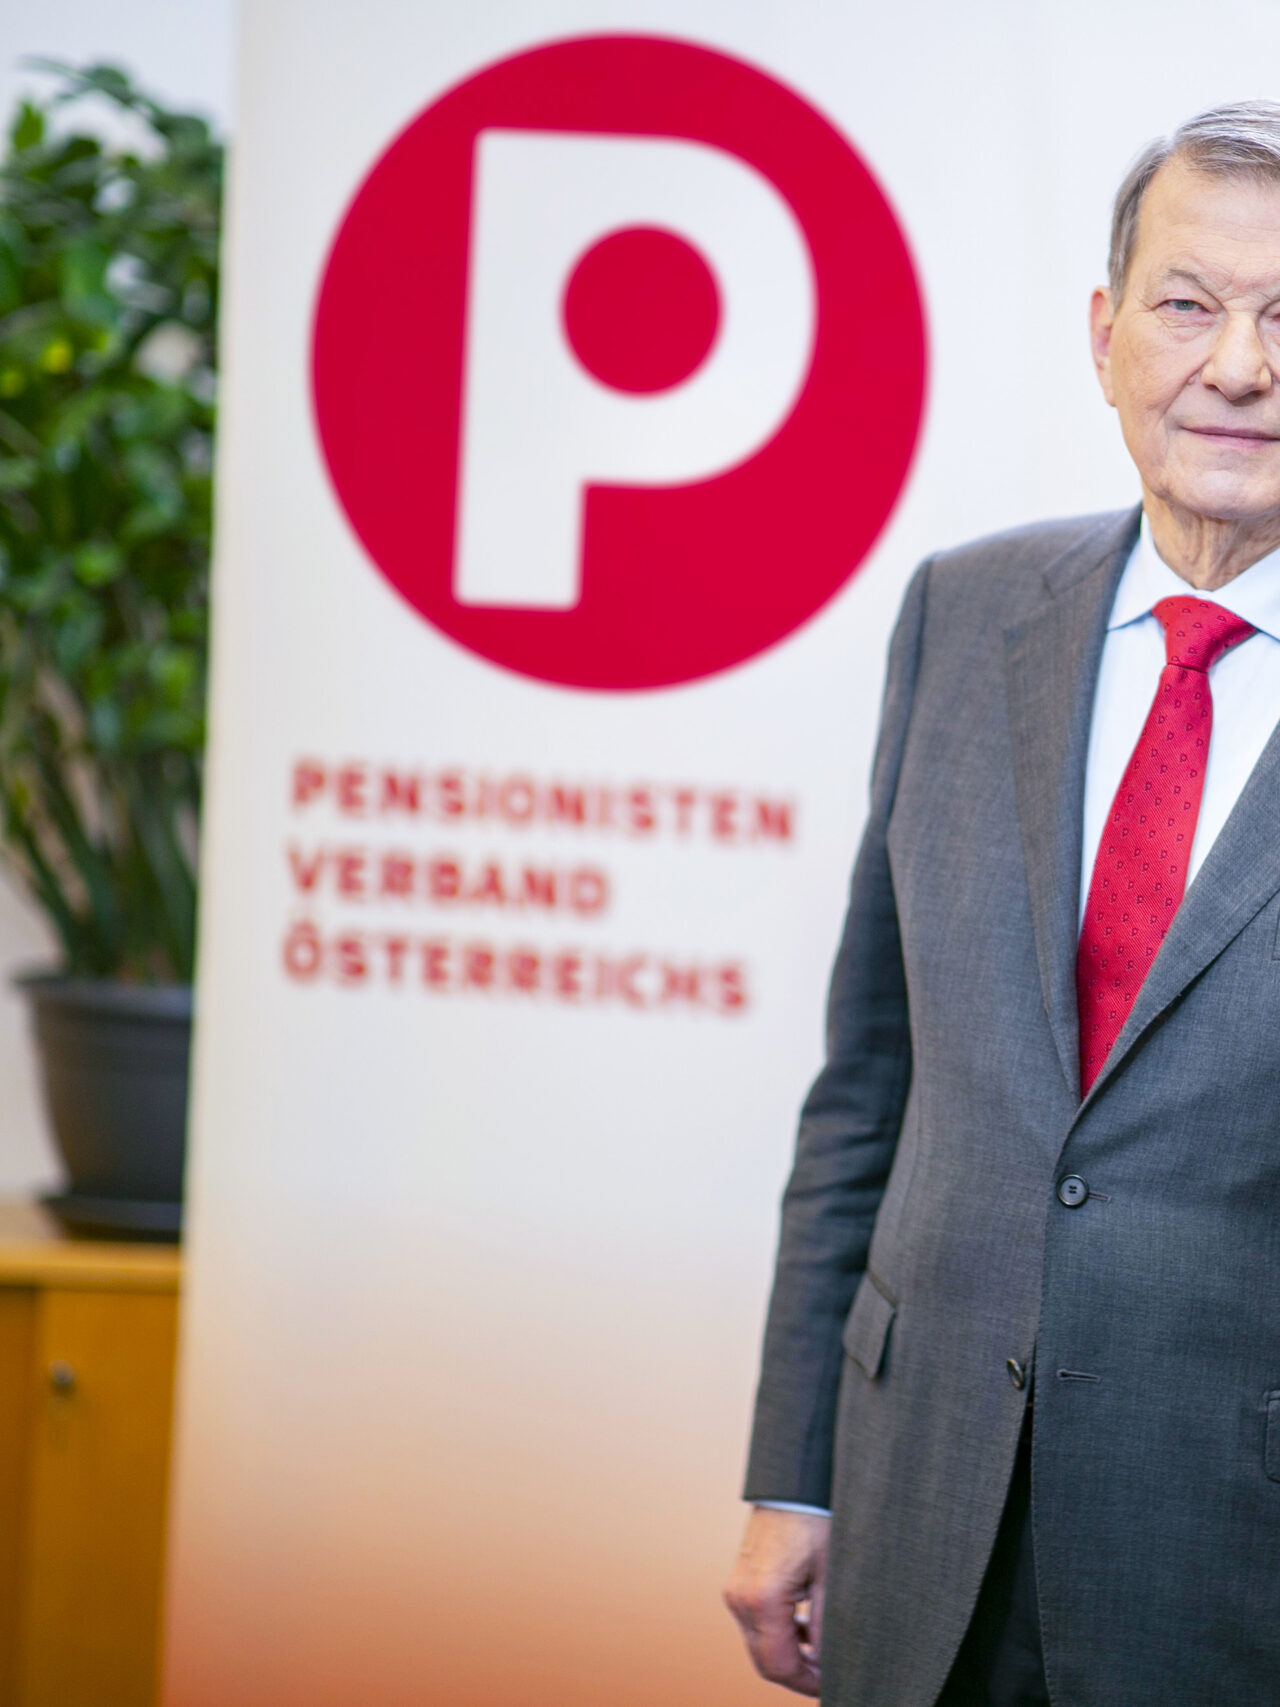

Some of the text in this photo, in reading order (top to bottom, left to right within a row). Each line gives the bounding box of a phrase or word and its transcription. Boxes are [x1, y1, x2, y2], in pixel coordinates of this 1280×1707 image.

[452, 127, 816, 611] P
[291, 757, 798, 842] PENSIONISTEN
[287, 845, 609, 919] VERBAND
[282, 908, 750, 1015] ÖSTERREICHS
